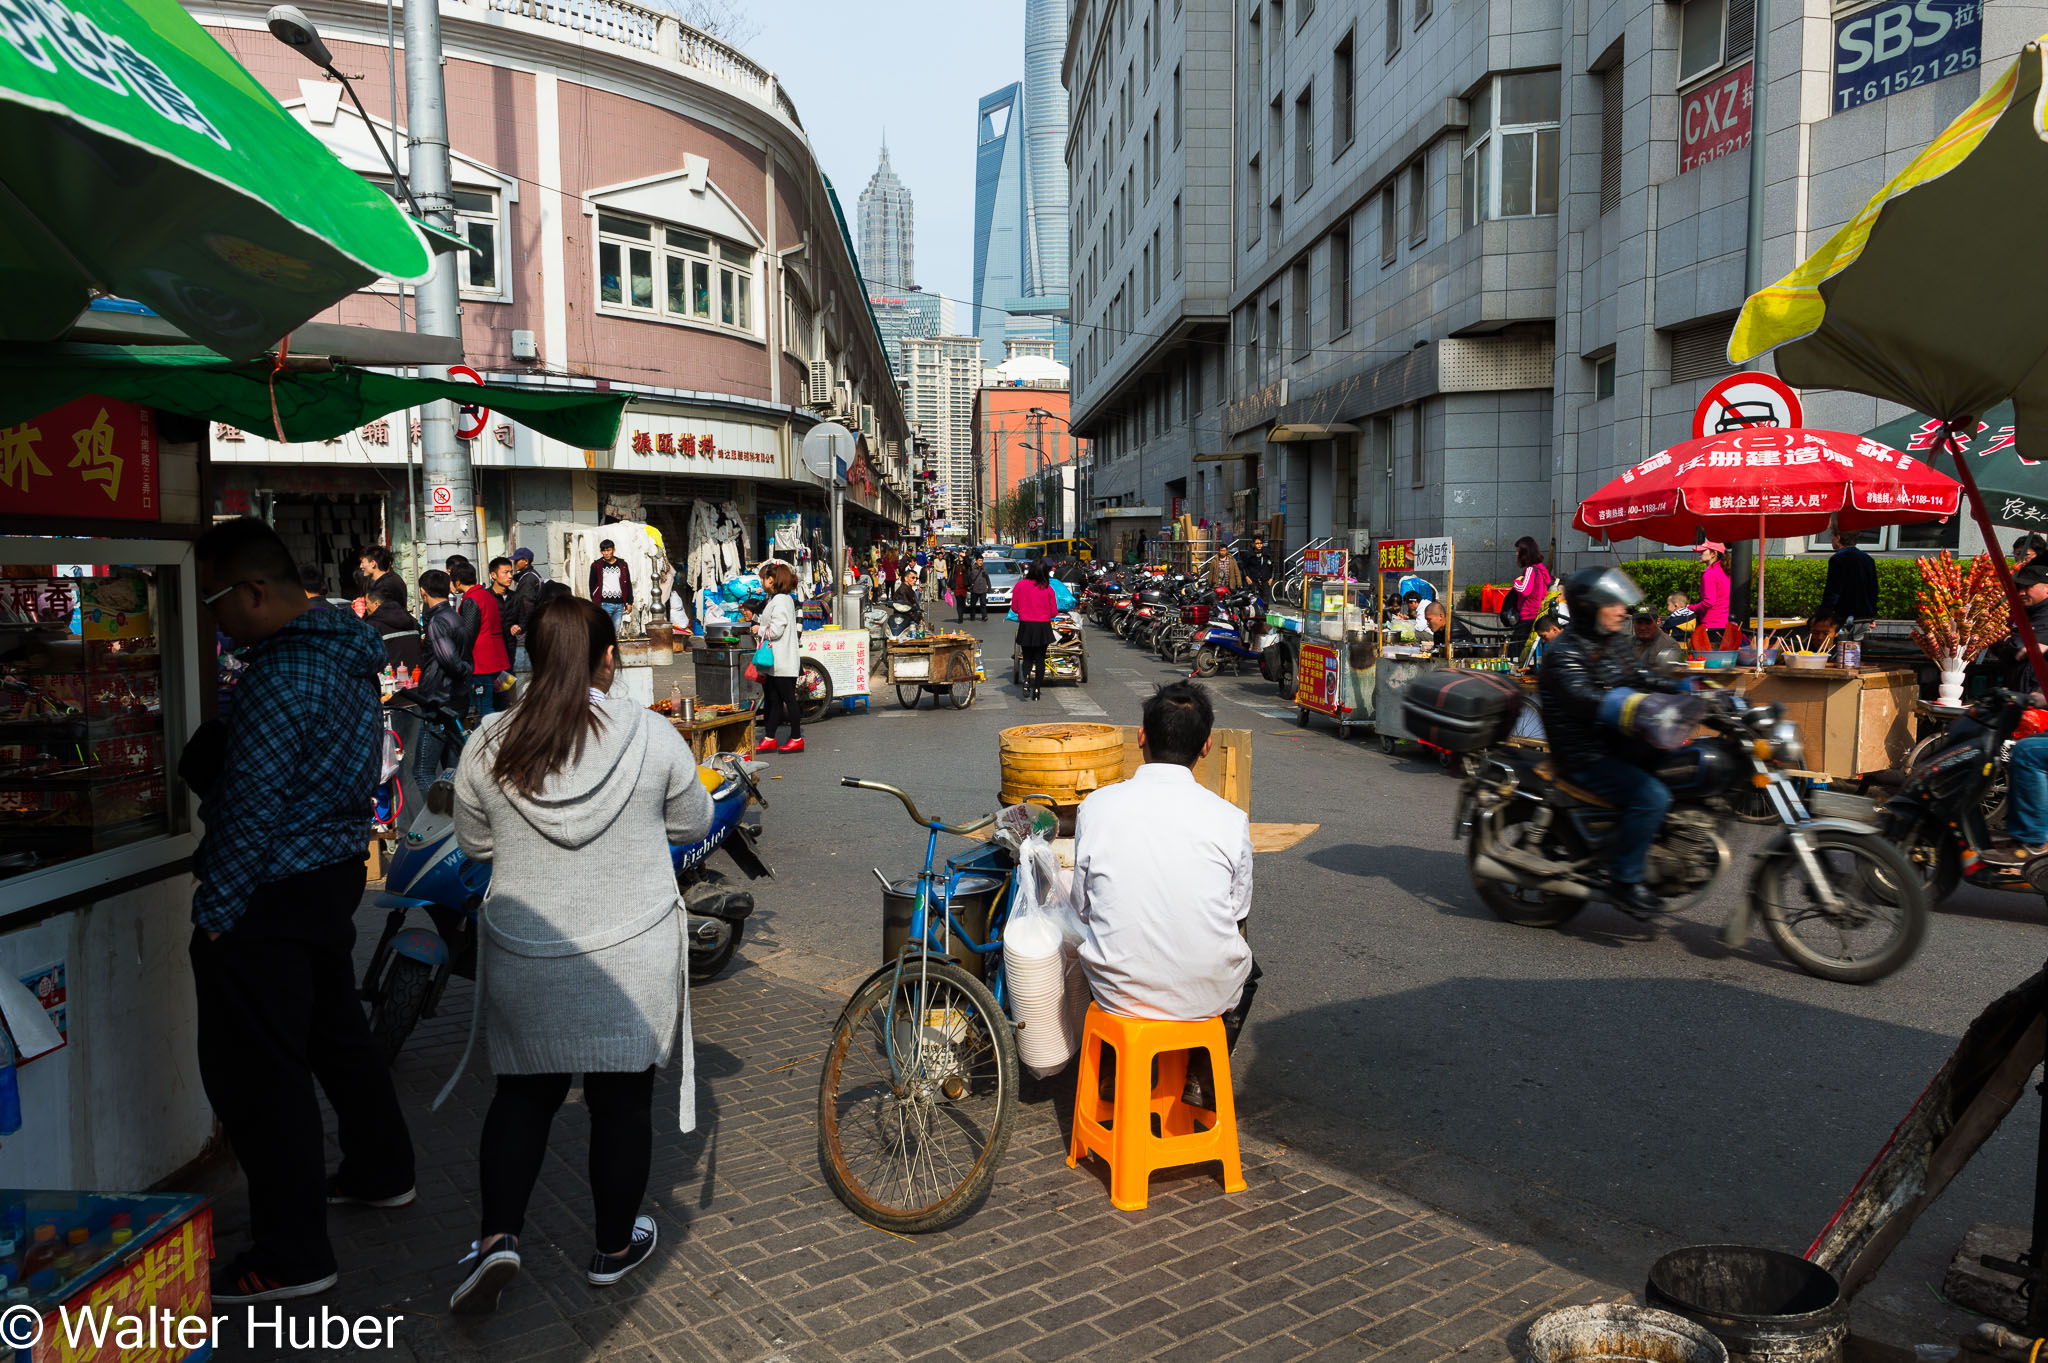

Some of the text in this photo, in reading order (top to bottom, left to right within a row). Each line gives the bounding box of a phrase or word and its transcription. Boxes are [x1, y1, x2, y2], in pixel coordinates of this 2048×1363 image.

[1838, 0, 1953, 75] SBS
[1839, 46, 1981, 109] T:6152125
[1685, 79, 1740, 145] CXZ
[631, 429, 717, 460] 振瓯辅料
[1674, 446, 1855, 478] 注册建造师
[1379, 544, 1406, 569] 肉夹馍
[1414, 541, 1448, 567] 长沙臭豆腐
